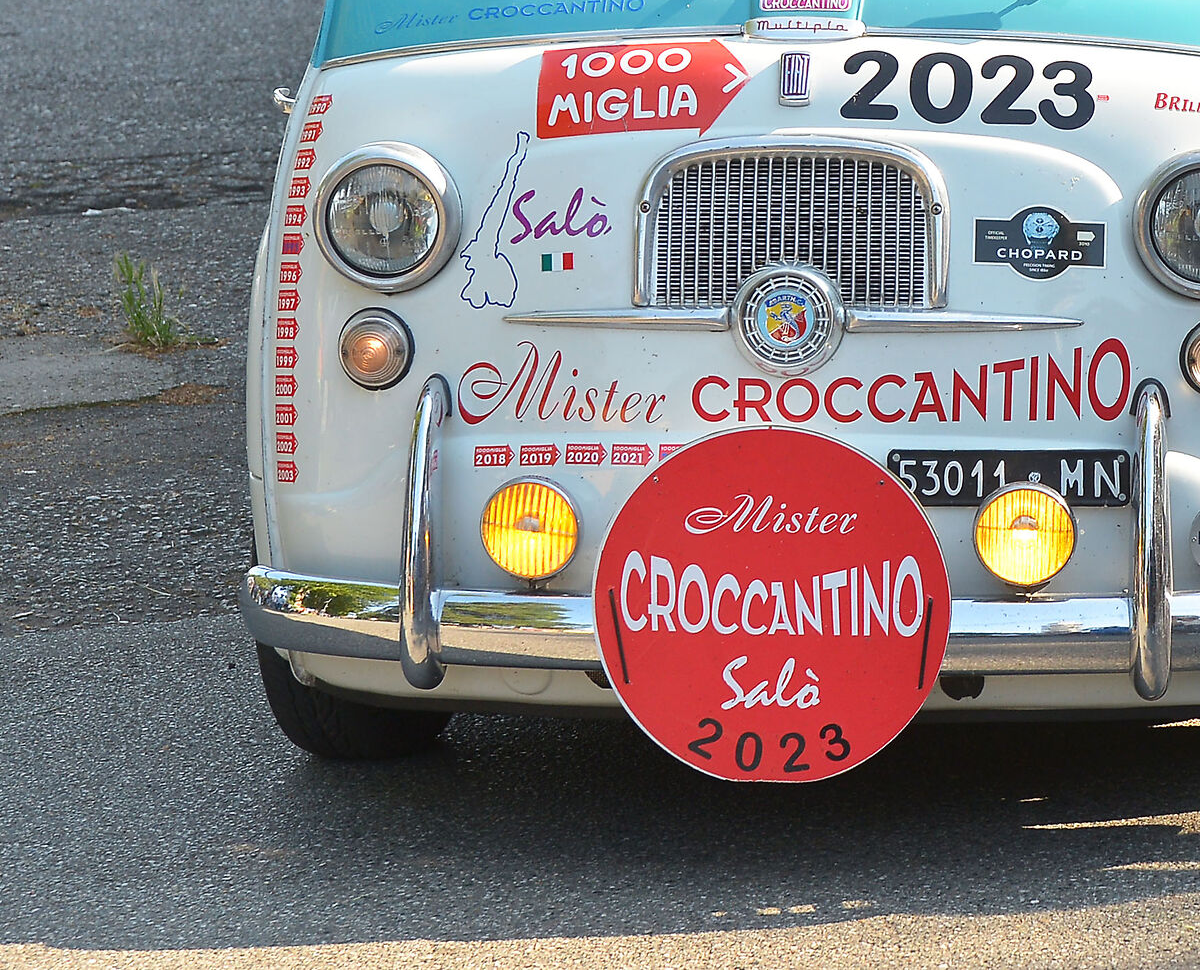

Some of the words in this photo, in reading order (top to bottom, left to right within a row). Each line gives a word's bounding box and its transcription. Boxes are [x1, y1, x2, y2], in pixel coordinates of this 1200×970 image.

[374, 9, 459, 34] Mister
[560, 47, 693, 79] 1000
[784, 54, 810, 96] FIAT
[839, 50, 1096, 131] 2023
[547, 84, 698, 127] MIGLIA
[285, 214, 302, 224] 1994
[510, 187, 613, 245] Salò
[996, 248, 1083, 261] CHOPARD
[280, 271, 297, 281] 1996
[278, 298, 295, 309] 1997
[277, 327, 294, 338] 1998
[276, 356, 293, 366] 1999
[458, 340, 668, 425] Mister
[692, 337, 1131, 424] CROCCANTINO
[276, 384, 293, 394] 2000
[276, 413, 293, 423] 2001
[277, 441, 293, 452] 2002
[475, 454, 506, 465] 2018
[521, 453, 552, 464] 2019
[567, 452, 599, 463] 2020
[613, 452, 643, 463] 2021
[278, 470, 294, 480] 2003
[900, 460, 1006, 497] 53011
[1061, 459, 1120, 498] MN
[684, 494, 858, 534] Mister
[620, 550, 924, 637] CROCCANTINO
[721, 655, 821, 711] Salò
[687, 717, 851, 773] 2023
